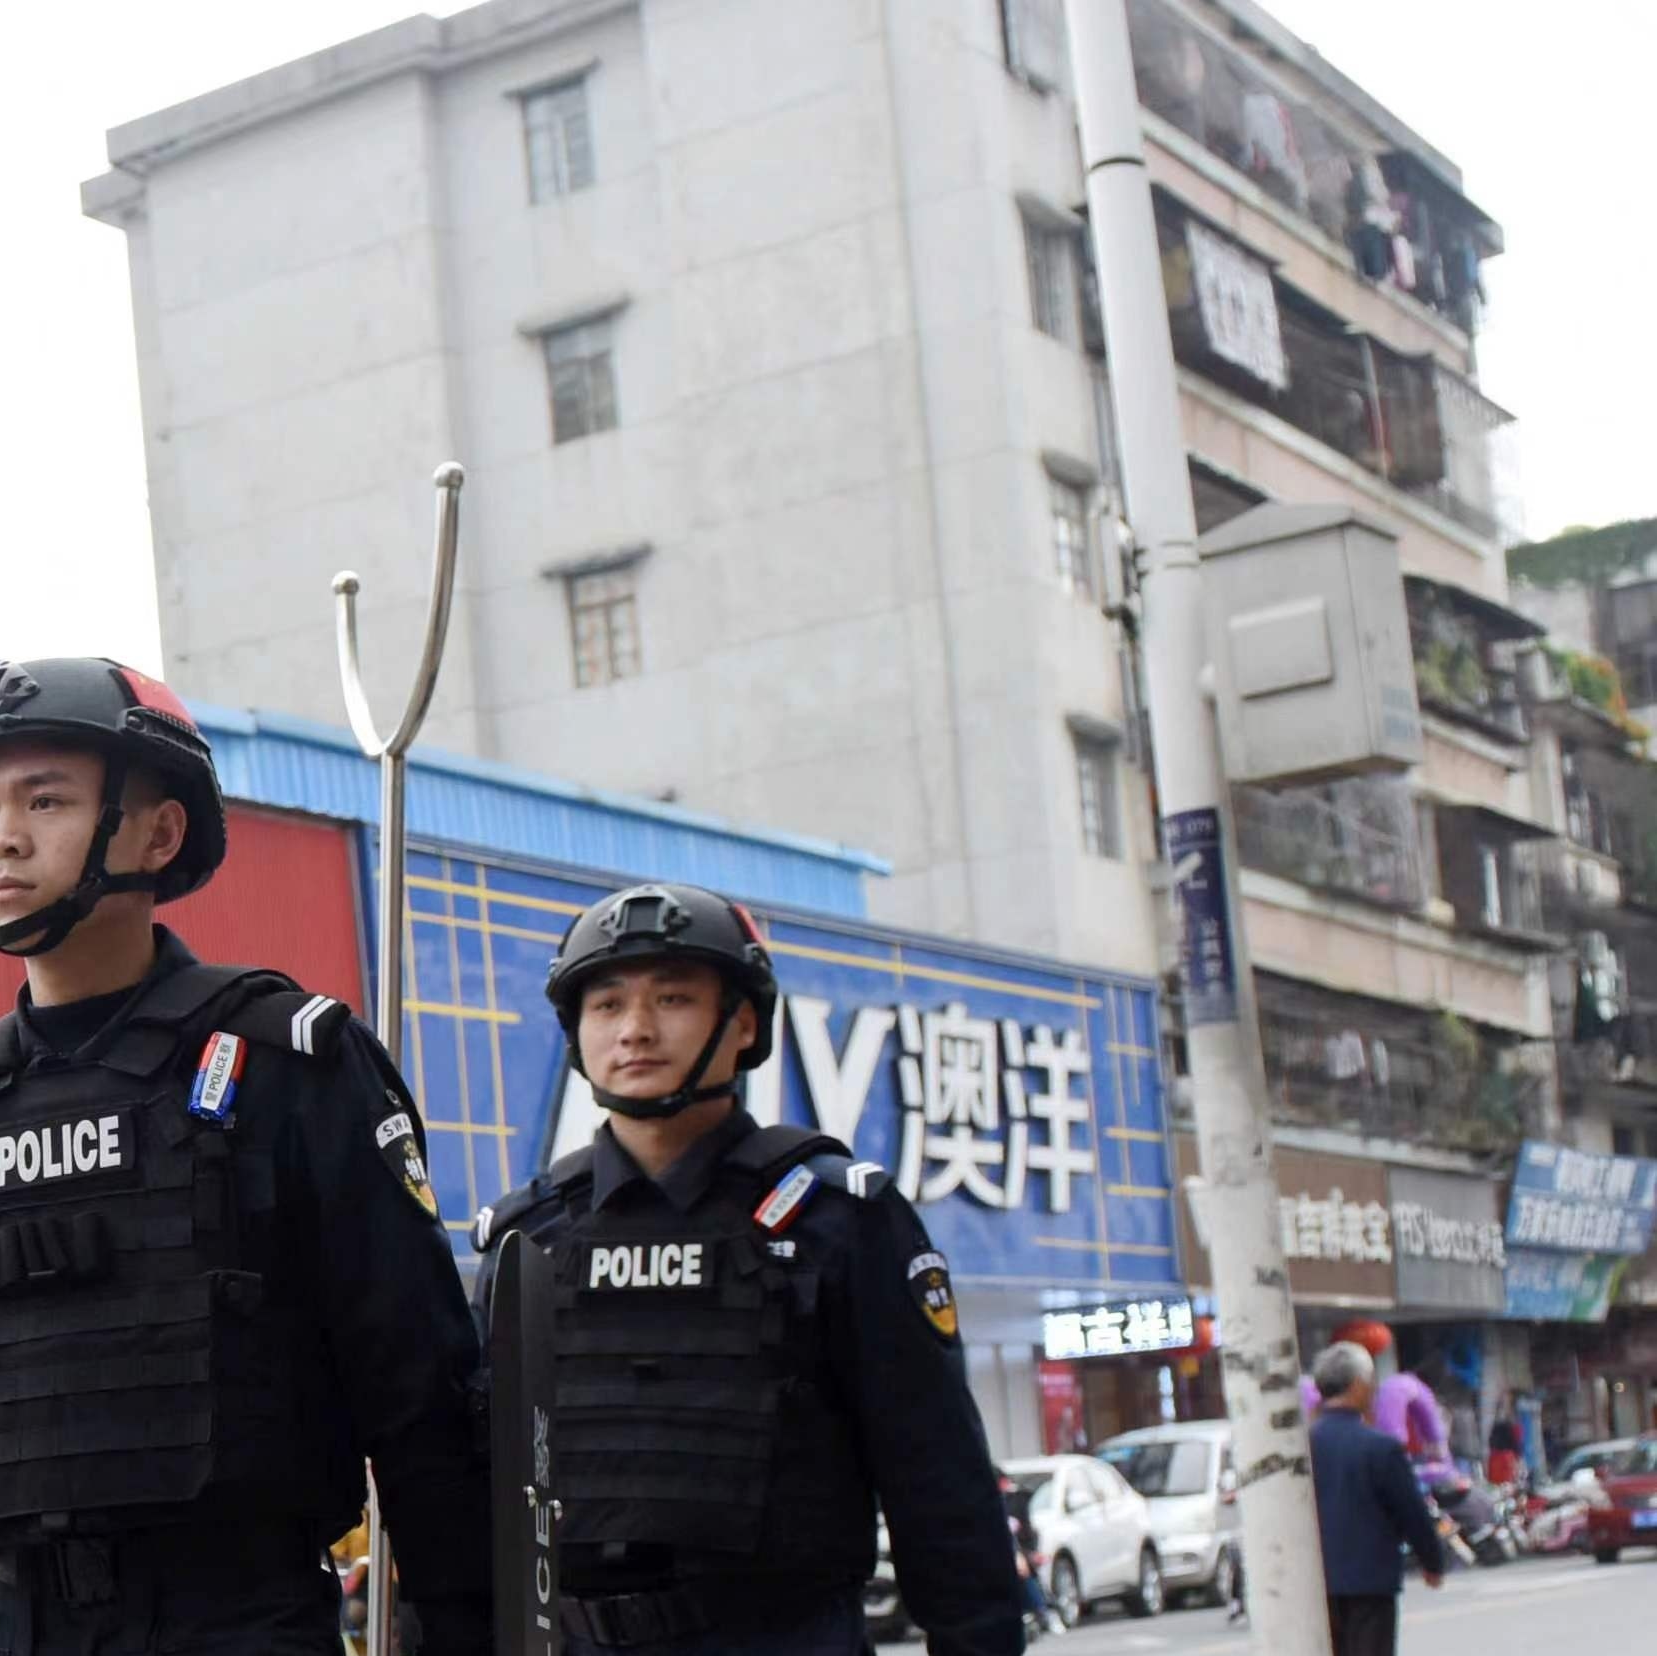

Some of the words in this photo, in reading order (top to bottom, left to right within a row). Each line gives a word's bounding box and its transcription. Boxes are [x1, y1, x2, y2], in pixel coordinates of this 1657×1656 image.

[208, 1054, 229, 1091] POLICE
[896, 1000, 1094, 1214] 澳洋
[589, 1242, 704, 1289] POLICE
